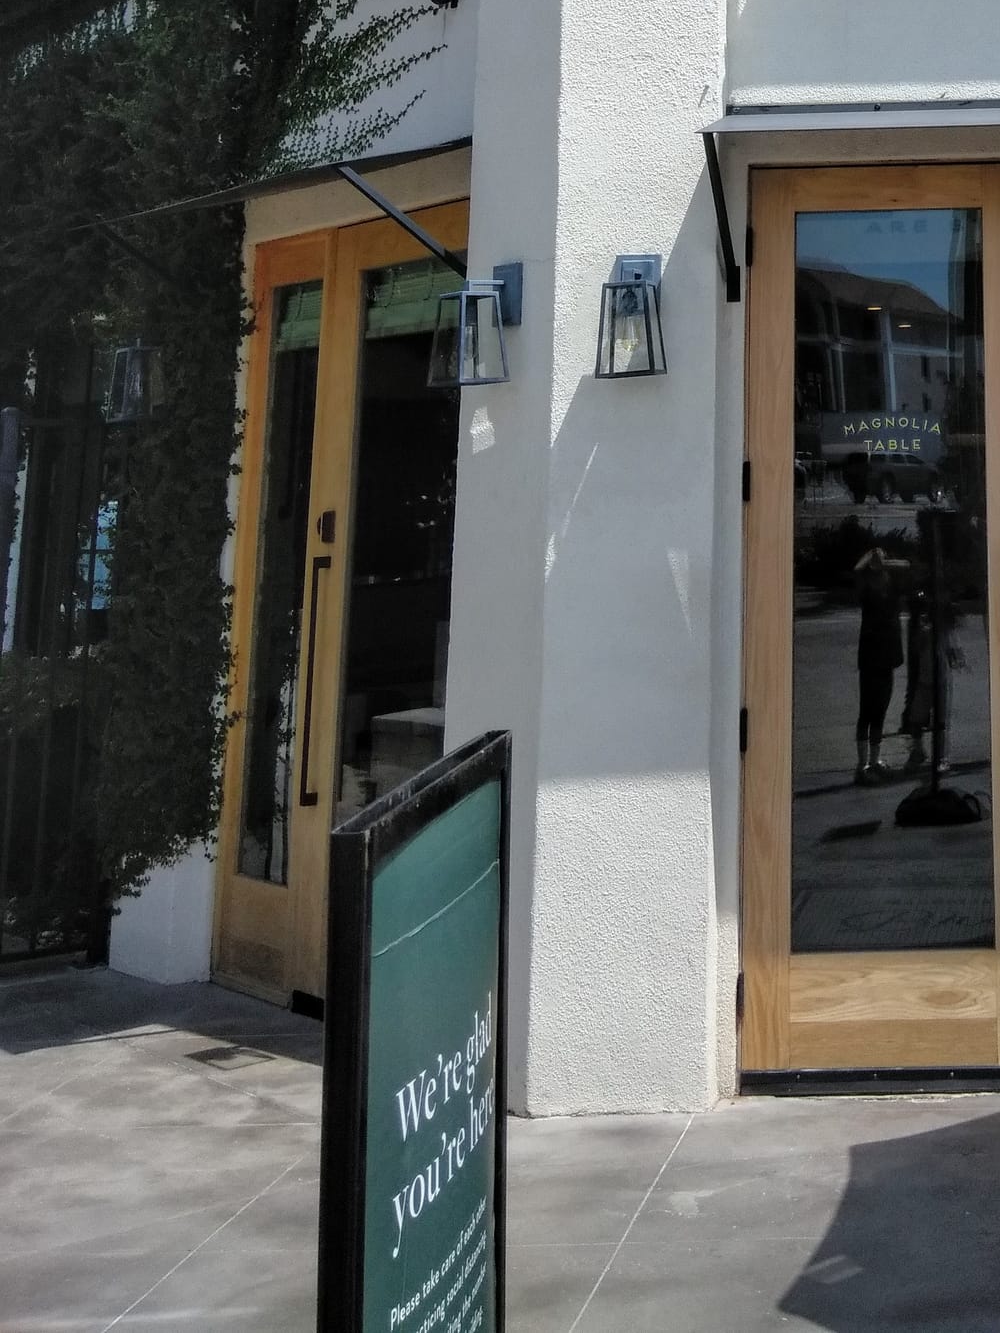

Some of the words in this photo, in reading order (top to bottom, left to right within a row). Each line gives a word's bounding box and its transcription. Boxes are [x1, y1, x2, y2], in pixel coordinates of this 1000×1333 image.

[843, 417, 942, 436] MAGNOLIA
[864, 439, 921, 451] TABLE
[395, 1051, 463, 1142] We're
[466, 990, 492, 1094] glad
[393, 1127, 466, 1259] you're
[390, 1292, 420, 1332] Please
[422, 1268, 440, 1299] take
[441, 1249, 456, 1276] care
[456, 1230, 464, 1255] of
[447, 1265, 464, 1306] social
